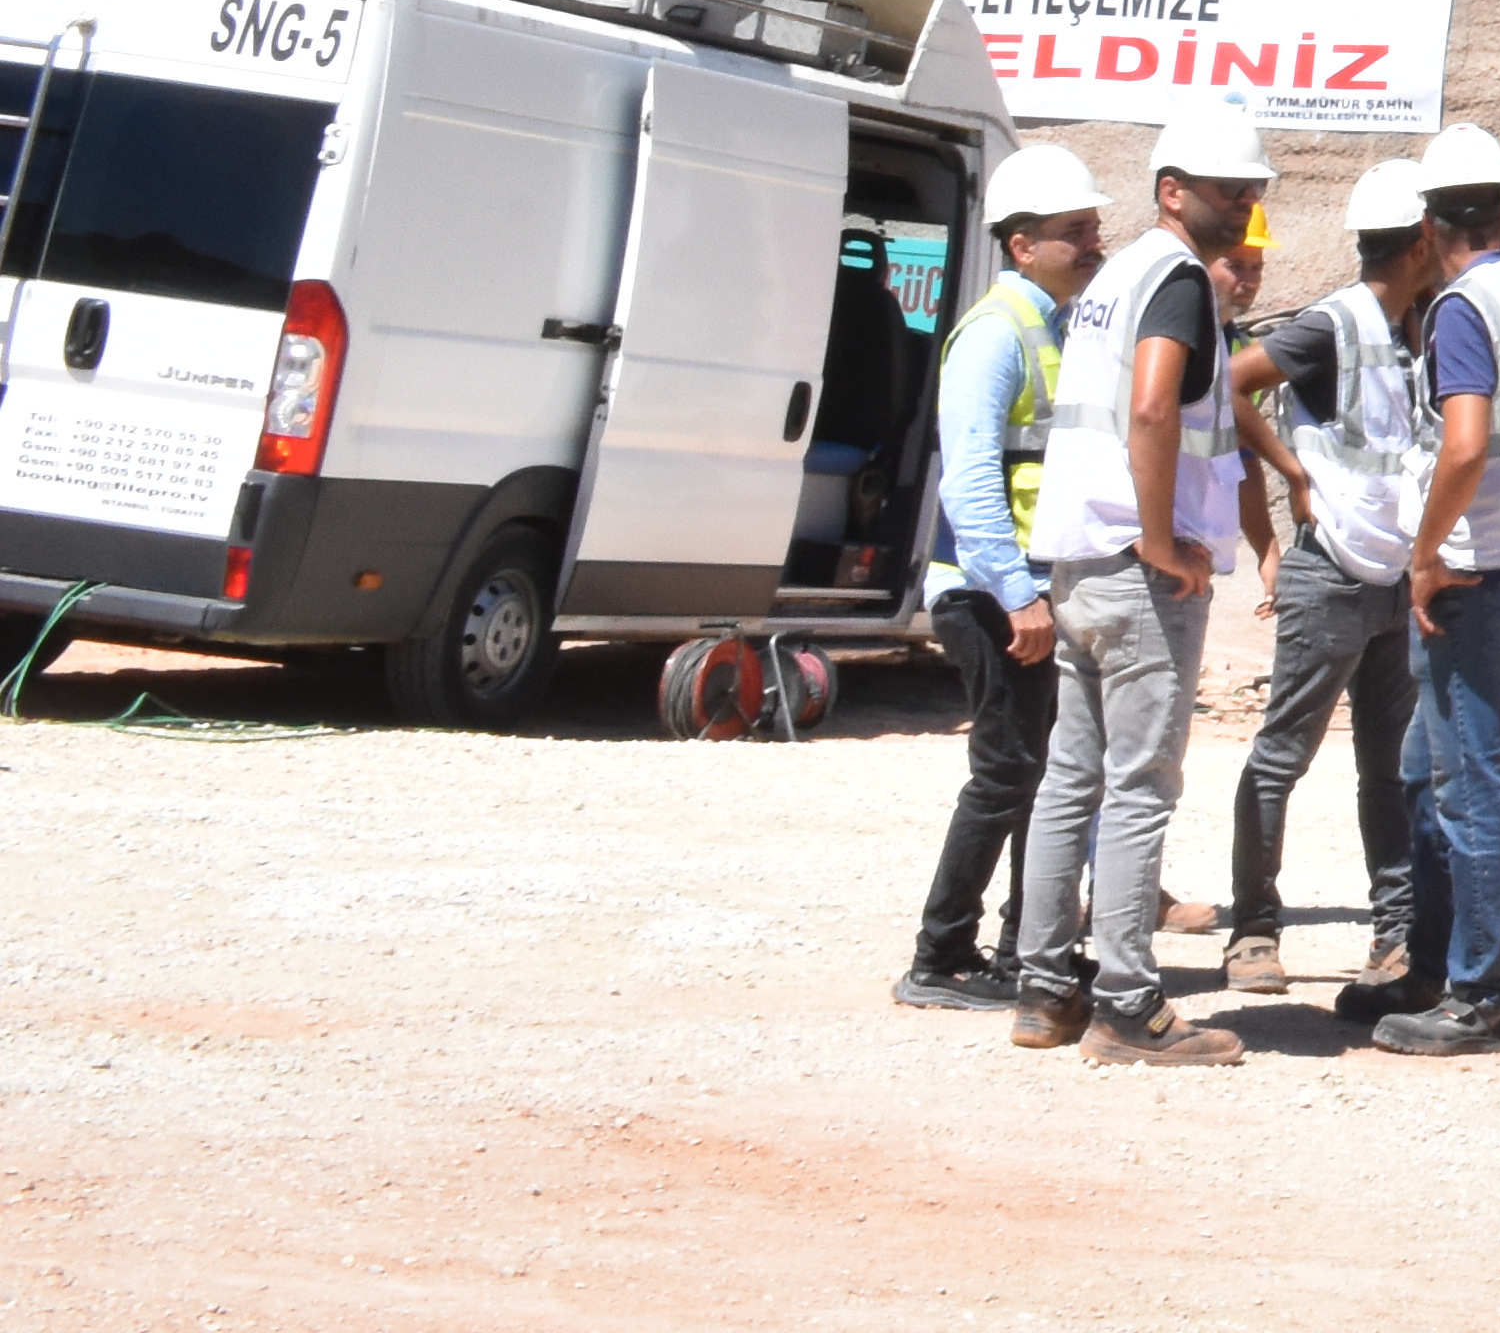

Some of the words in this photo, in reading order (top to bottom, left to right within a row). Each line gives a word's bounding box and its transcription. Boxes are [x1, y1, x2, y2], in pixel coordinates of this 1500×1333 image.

[1366, 98, 1413, 111] ŞAHİN
[1315, 111, 1370, 121] BELEDİYE
[157, 366, 254, 391] JUMPER
[75, 419, 103, 429] +90
[109, 422, 137, 434] 212
[144, 428, 173, 439] 570
[179, 433, 197, 442] 55
[203, 435, 222, 445] 30
[70, 447, 97, 458] +90
[103, 451, 132, 463] 532
[72, 433, 100, 443] +90
[105, 437, 133, 448] 212
[141, 442, 169, 453] 570
[200, 450, 219, 460] 45
[66, 462, 94, 472] +90
[135, 470, 163, 481] 517
[16, 469, 208, 502] booking@filepro.tv
